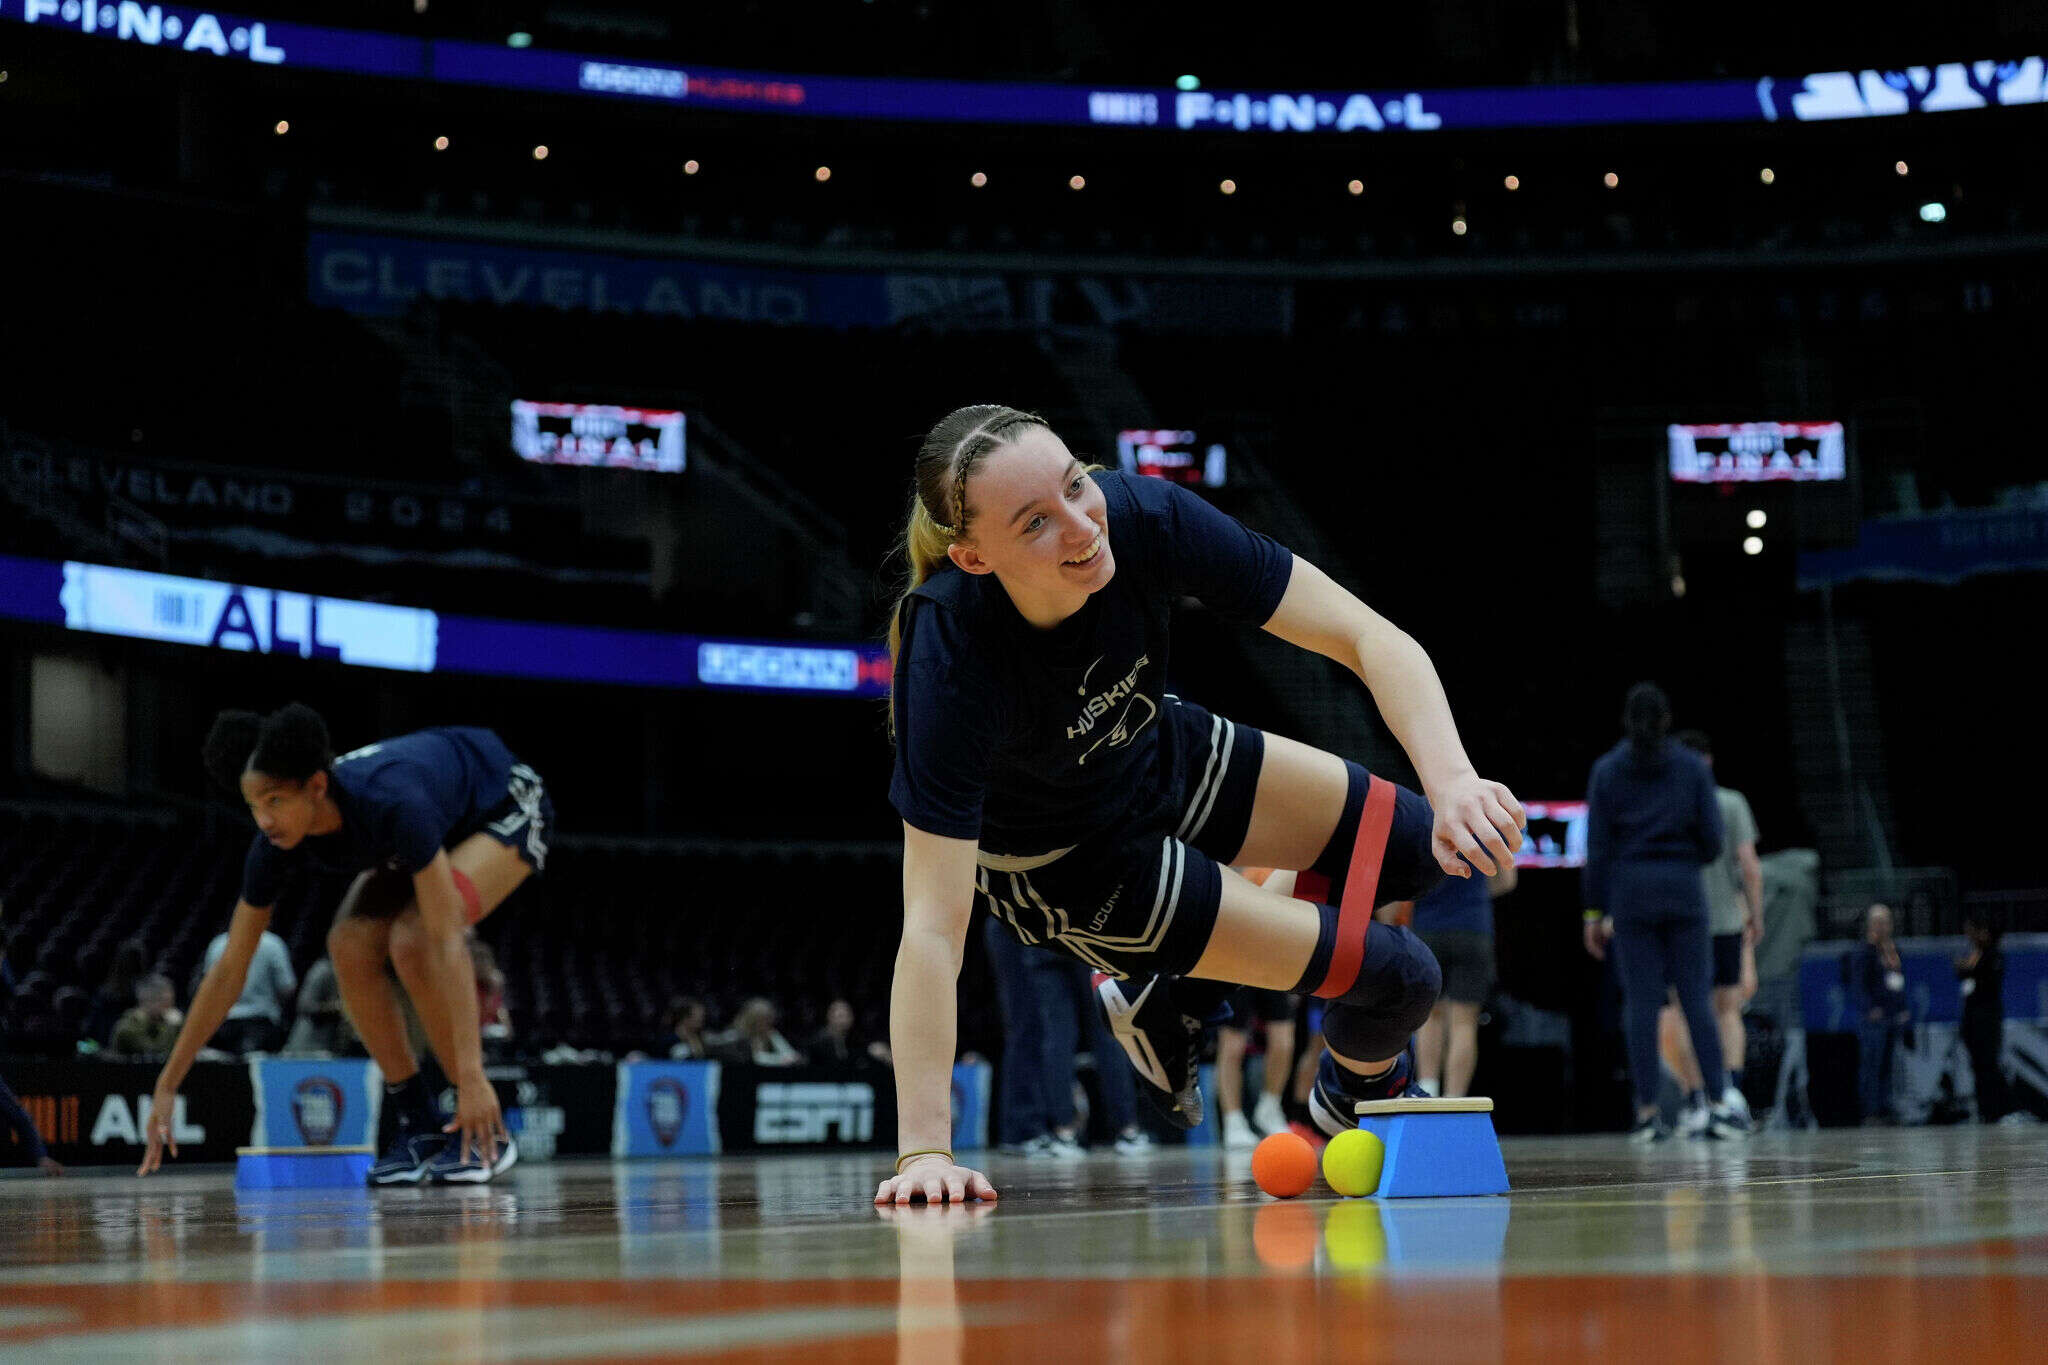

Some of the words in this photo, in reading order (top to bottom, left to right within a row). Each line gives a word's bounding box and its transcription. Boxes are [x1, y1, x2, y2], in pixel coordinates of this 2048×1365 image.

[320, 249, 807, 324] CLEVELAND
[210, 583, 341, 664] ALL
[754, 1082, 874, 1143] ESPN
